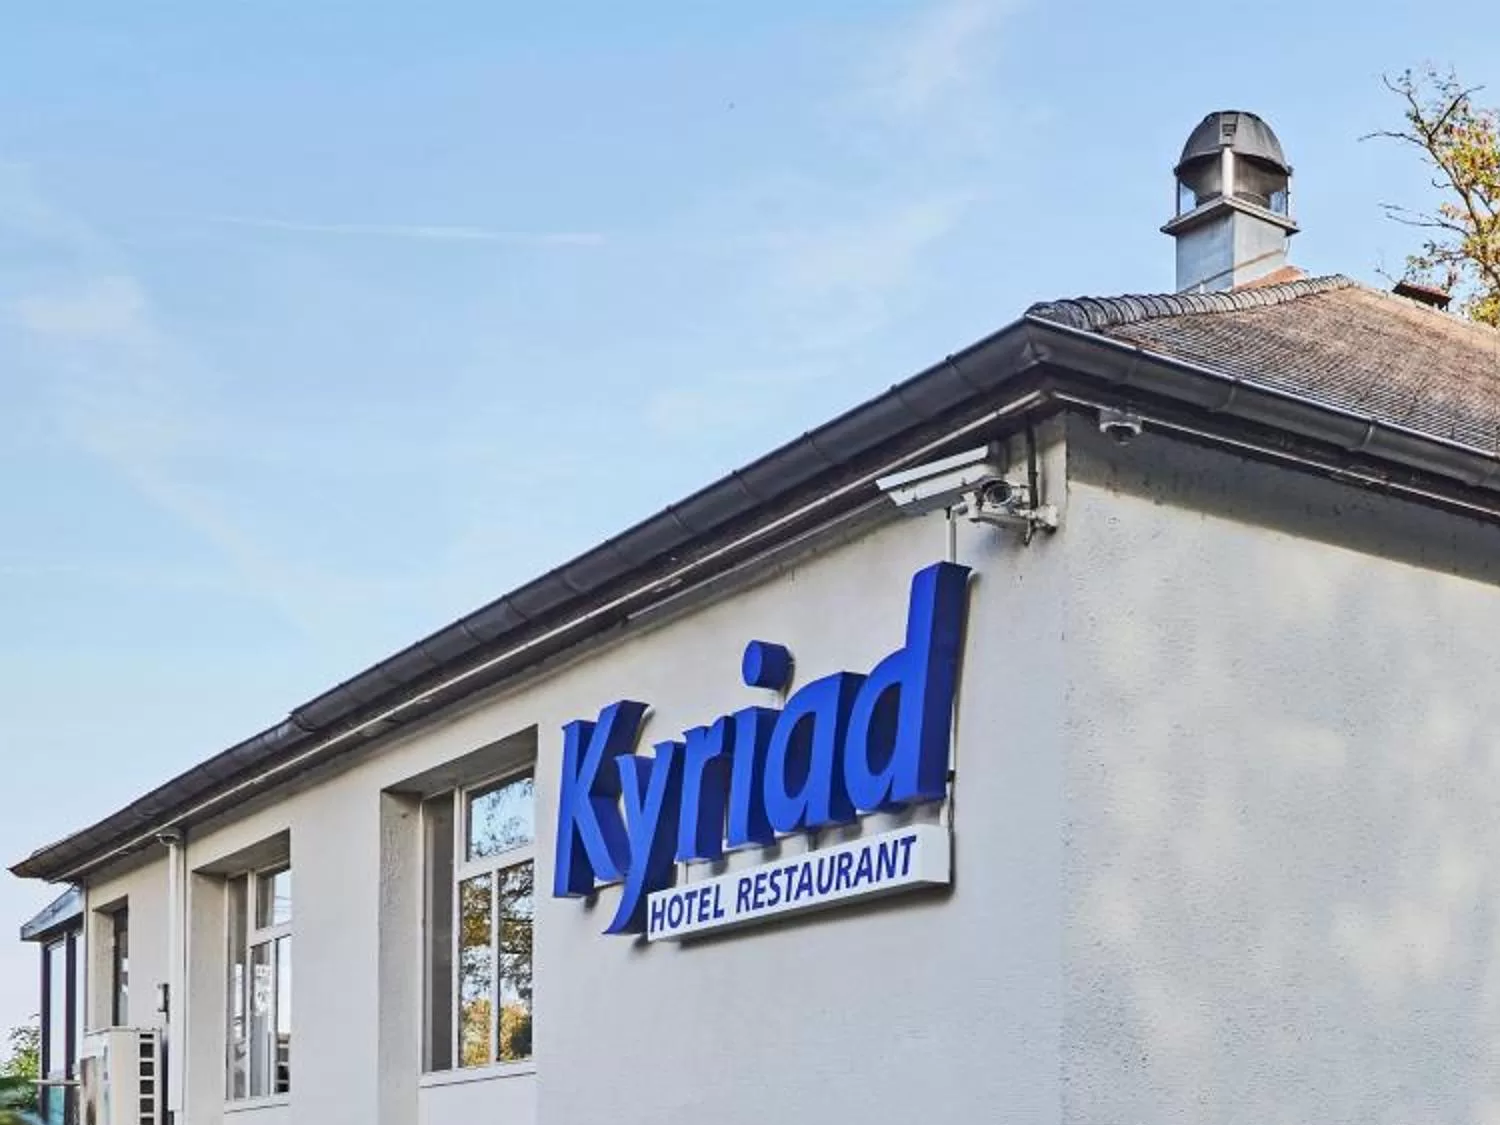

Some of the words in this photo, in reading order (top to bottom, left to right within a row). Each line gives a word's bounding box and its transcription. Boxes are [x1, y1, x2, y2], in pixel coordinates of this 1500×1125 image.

[553, 561, 971, 934] Kyriad
[650, 885, 724, 932] HOTEL
[736, 835, 917, 913] RESTAURANT
